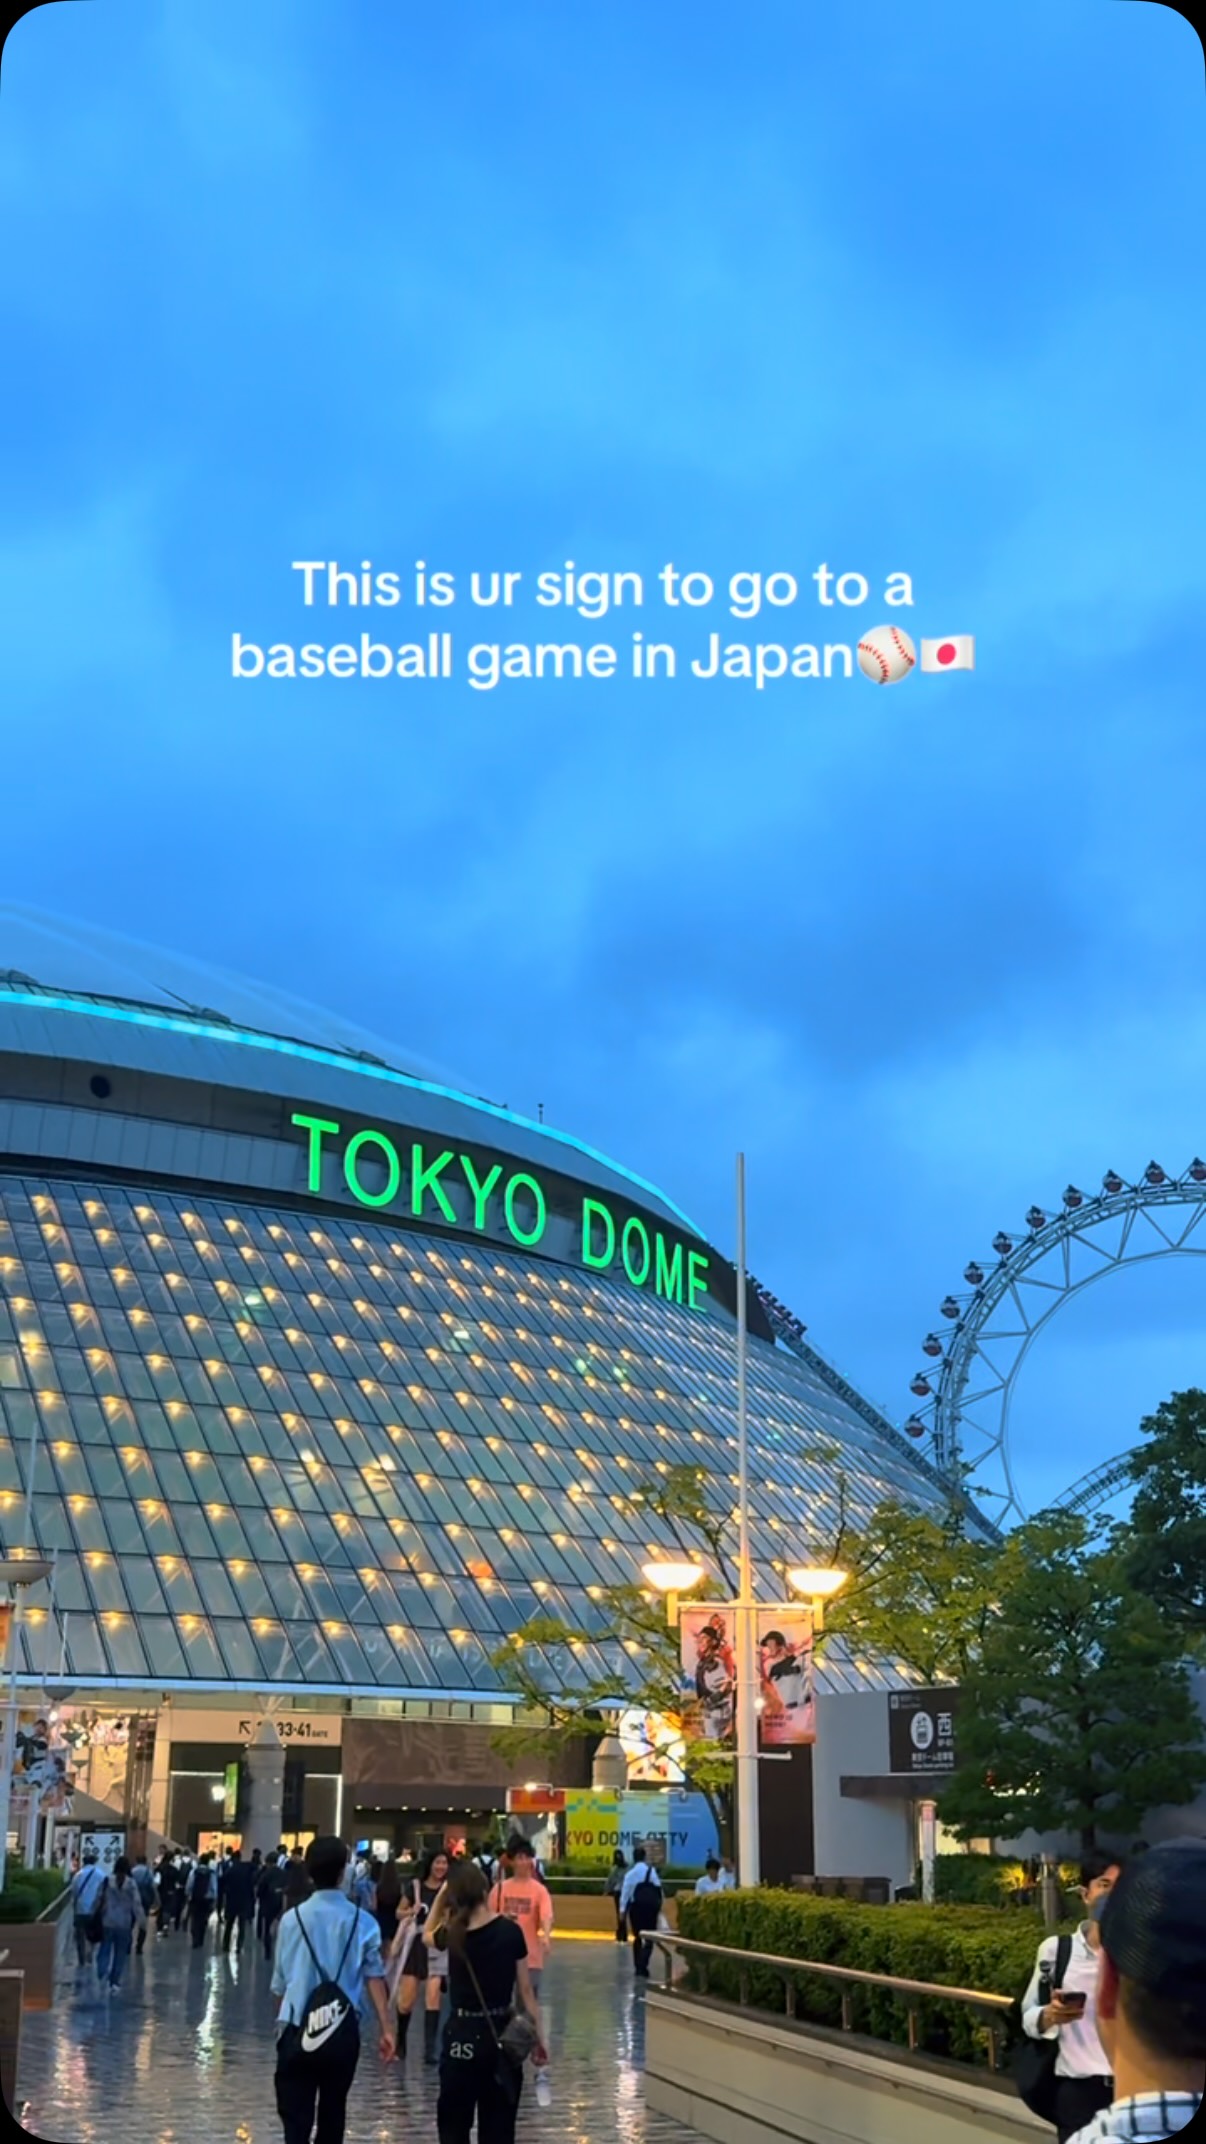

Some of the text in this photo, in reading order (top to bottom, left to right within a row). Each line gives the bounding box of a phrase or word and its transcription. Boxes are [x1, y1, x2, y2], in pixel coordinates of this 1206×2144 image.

[291, 1112, 710, 1312] TOKYO DOME
[598, 1830, 641, 1847] DOME
[308, 1998, 343, 2034] NIKE
[449, 2041, 475, 2060] as
